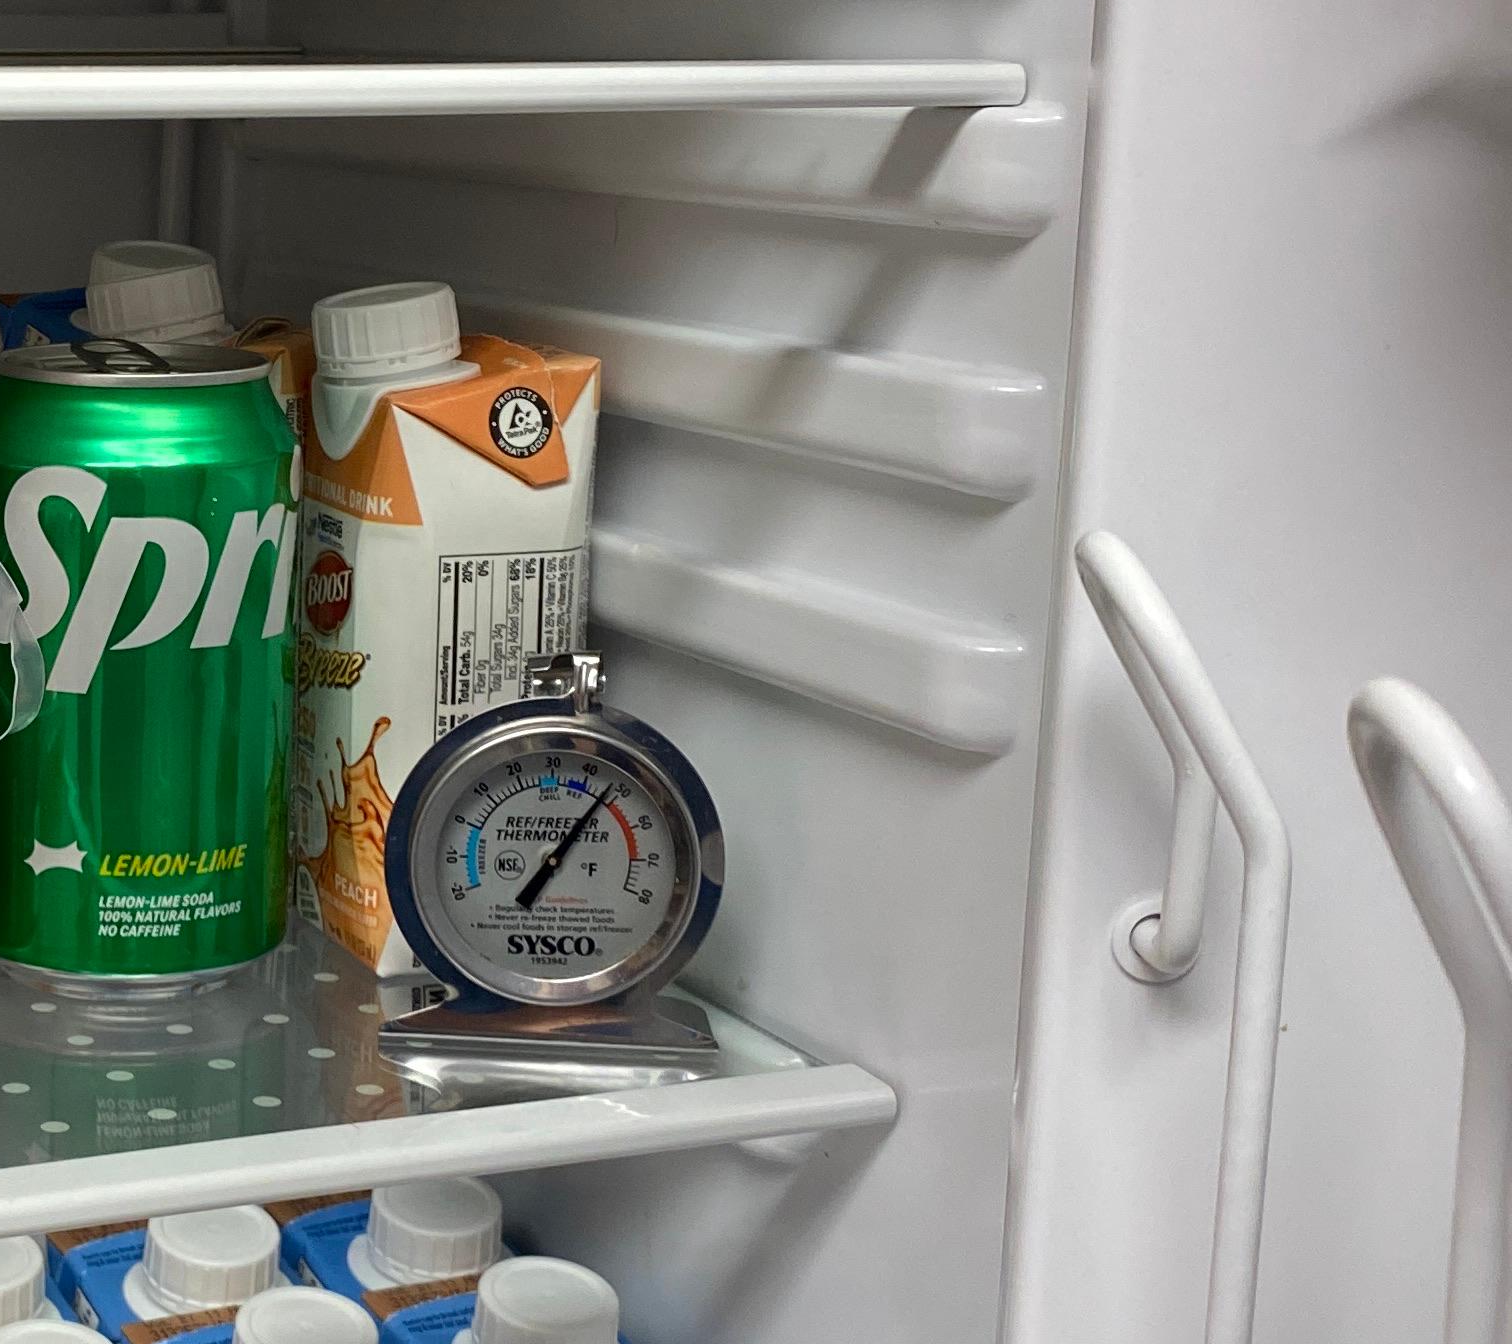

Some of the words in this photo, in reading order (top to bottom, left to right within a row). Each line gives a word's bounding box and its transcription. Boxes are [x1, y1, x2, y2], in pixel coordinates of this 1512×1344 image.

[495, 388, 539, 410] PROTECTS
[529, 426, 550, 454] GOOD
[349, 490, 394, 519] DRINK
[306, 567, 354, 607] BOOST
[299, 632, 366, 694] Breeze
[458, 676, 470, 706] Total
[505, 761, 523, 777] 20
[544, 756, 561, 769] 30
[581, 761, 598, 777] 40
[473, 781, 490, 798] 10
[615, 782, 632, 800] 50
[454, 813, 466, 825] 0
[505, 816, 599, 830] REF/FREER
[638, 813, 653, 832] 60
[98, 843, 248, 878] LEMON-LIME
[446, 847, 459, 865] -10
[498, 857, 519, 873] NSF
[647, 852, 661, 869] 70
[98, 894, 181, 909] LEMON-LIME
[182, 891, 215, 907] SODA
[335, 873, 378, 909] PEACH
[451, 881, 466, 903] -20
[638, 888, 654, 906] 80
[98, 910, 133, 924] 100%
[134, 908, 192, 924] NATURAL
[194, 900, 242, 921] FLAVORS
[98, 923, 118, 937] NO
[119, 923, 182, 938] CAFFEINE
[507, 934, 597, 956] SYSCO
